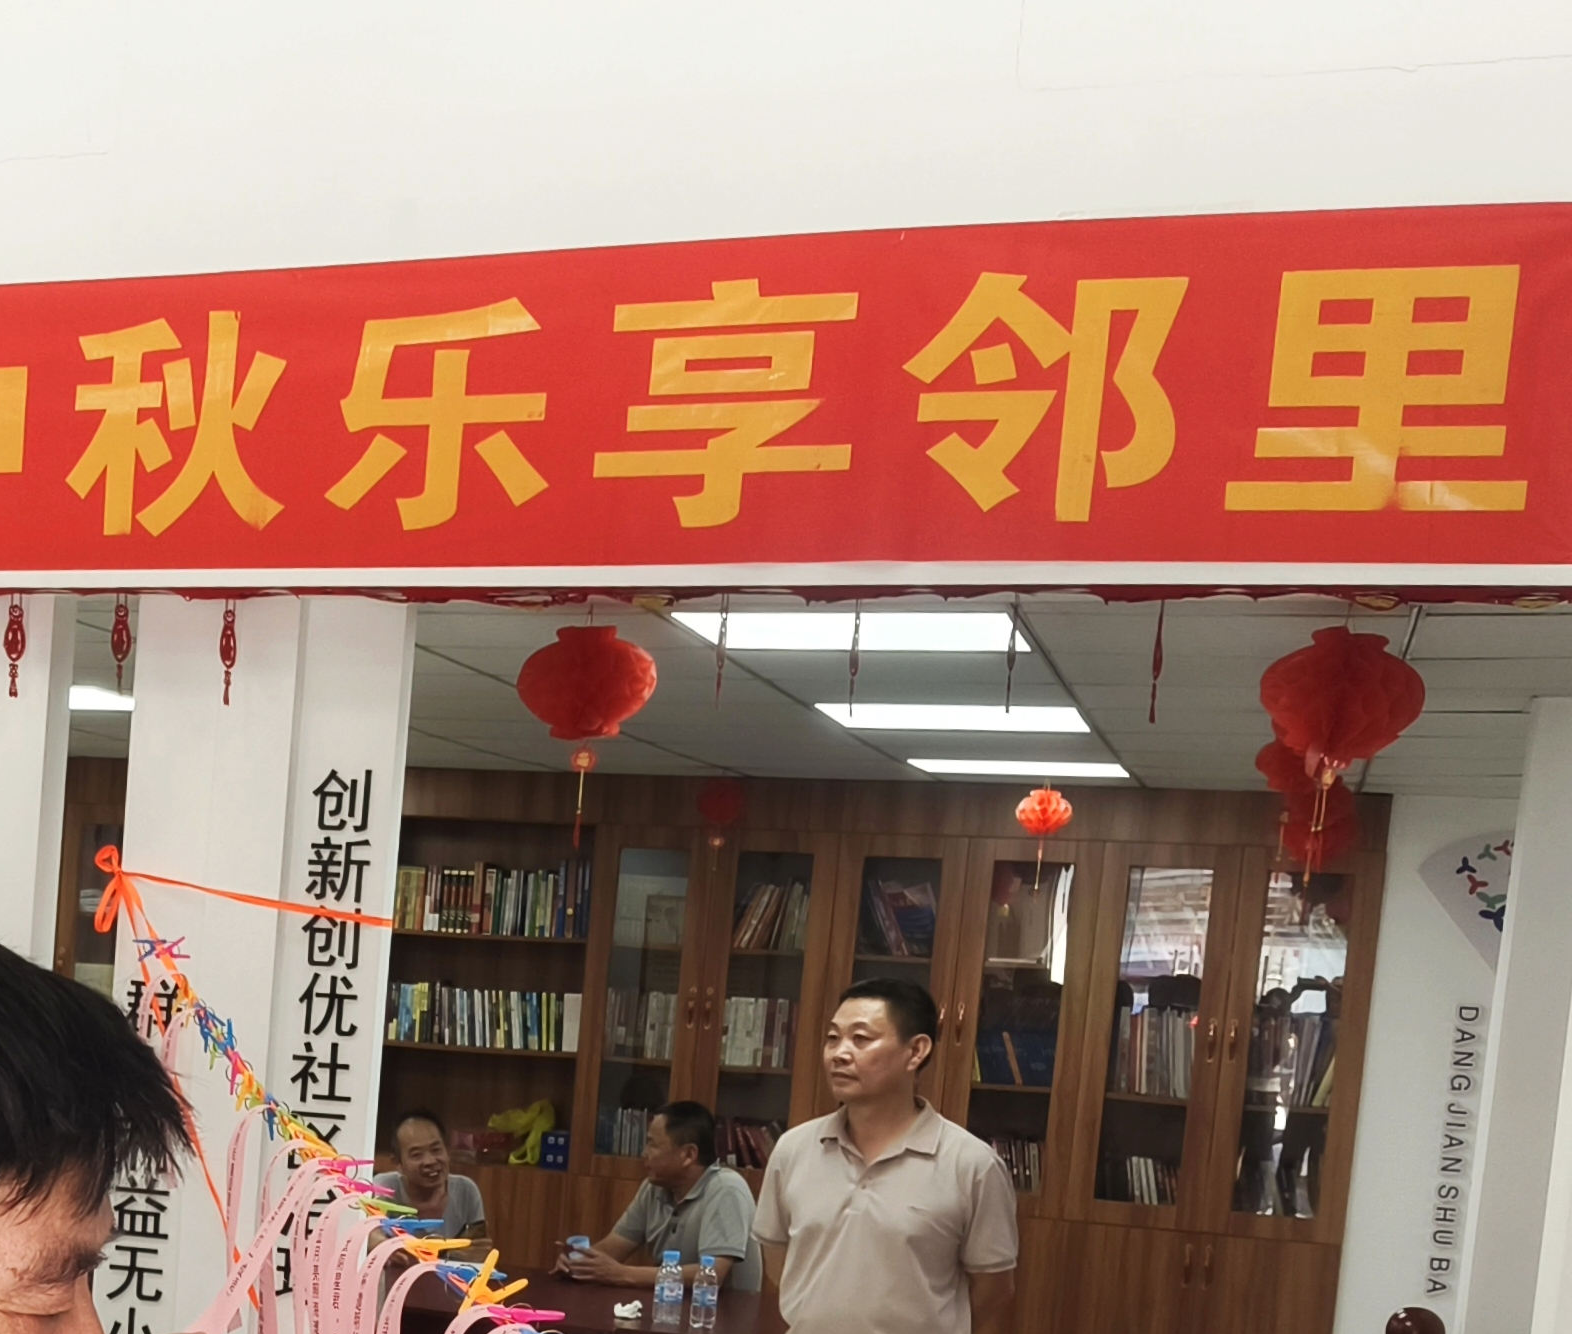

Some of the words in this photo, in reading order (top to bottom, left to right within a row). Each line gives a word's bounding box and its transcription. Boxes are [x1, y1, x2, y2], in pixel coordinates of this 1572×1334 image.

[1448, 1005, 1479, 1092] DANG
[1441, 1103, 1467, 1174] JIAN
[1432, 1183, 1460, 1246] SHU
[1425, 1257, 1451, 1296] BA
